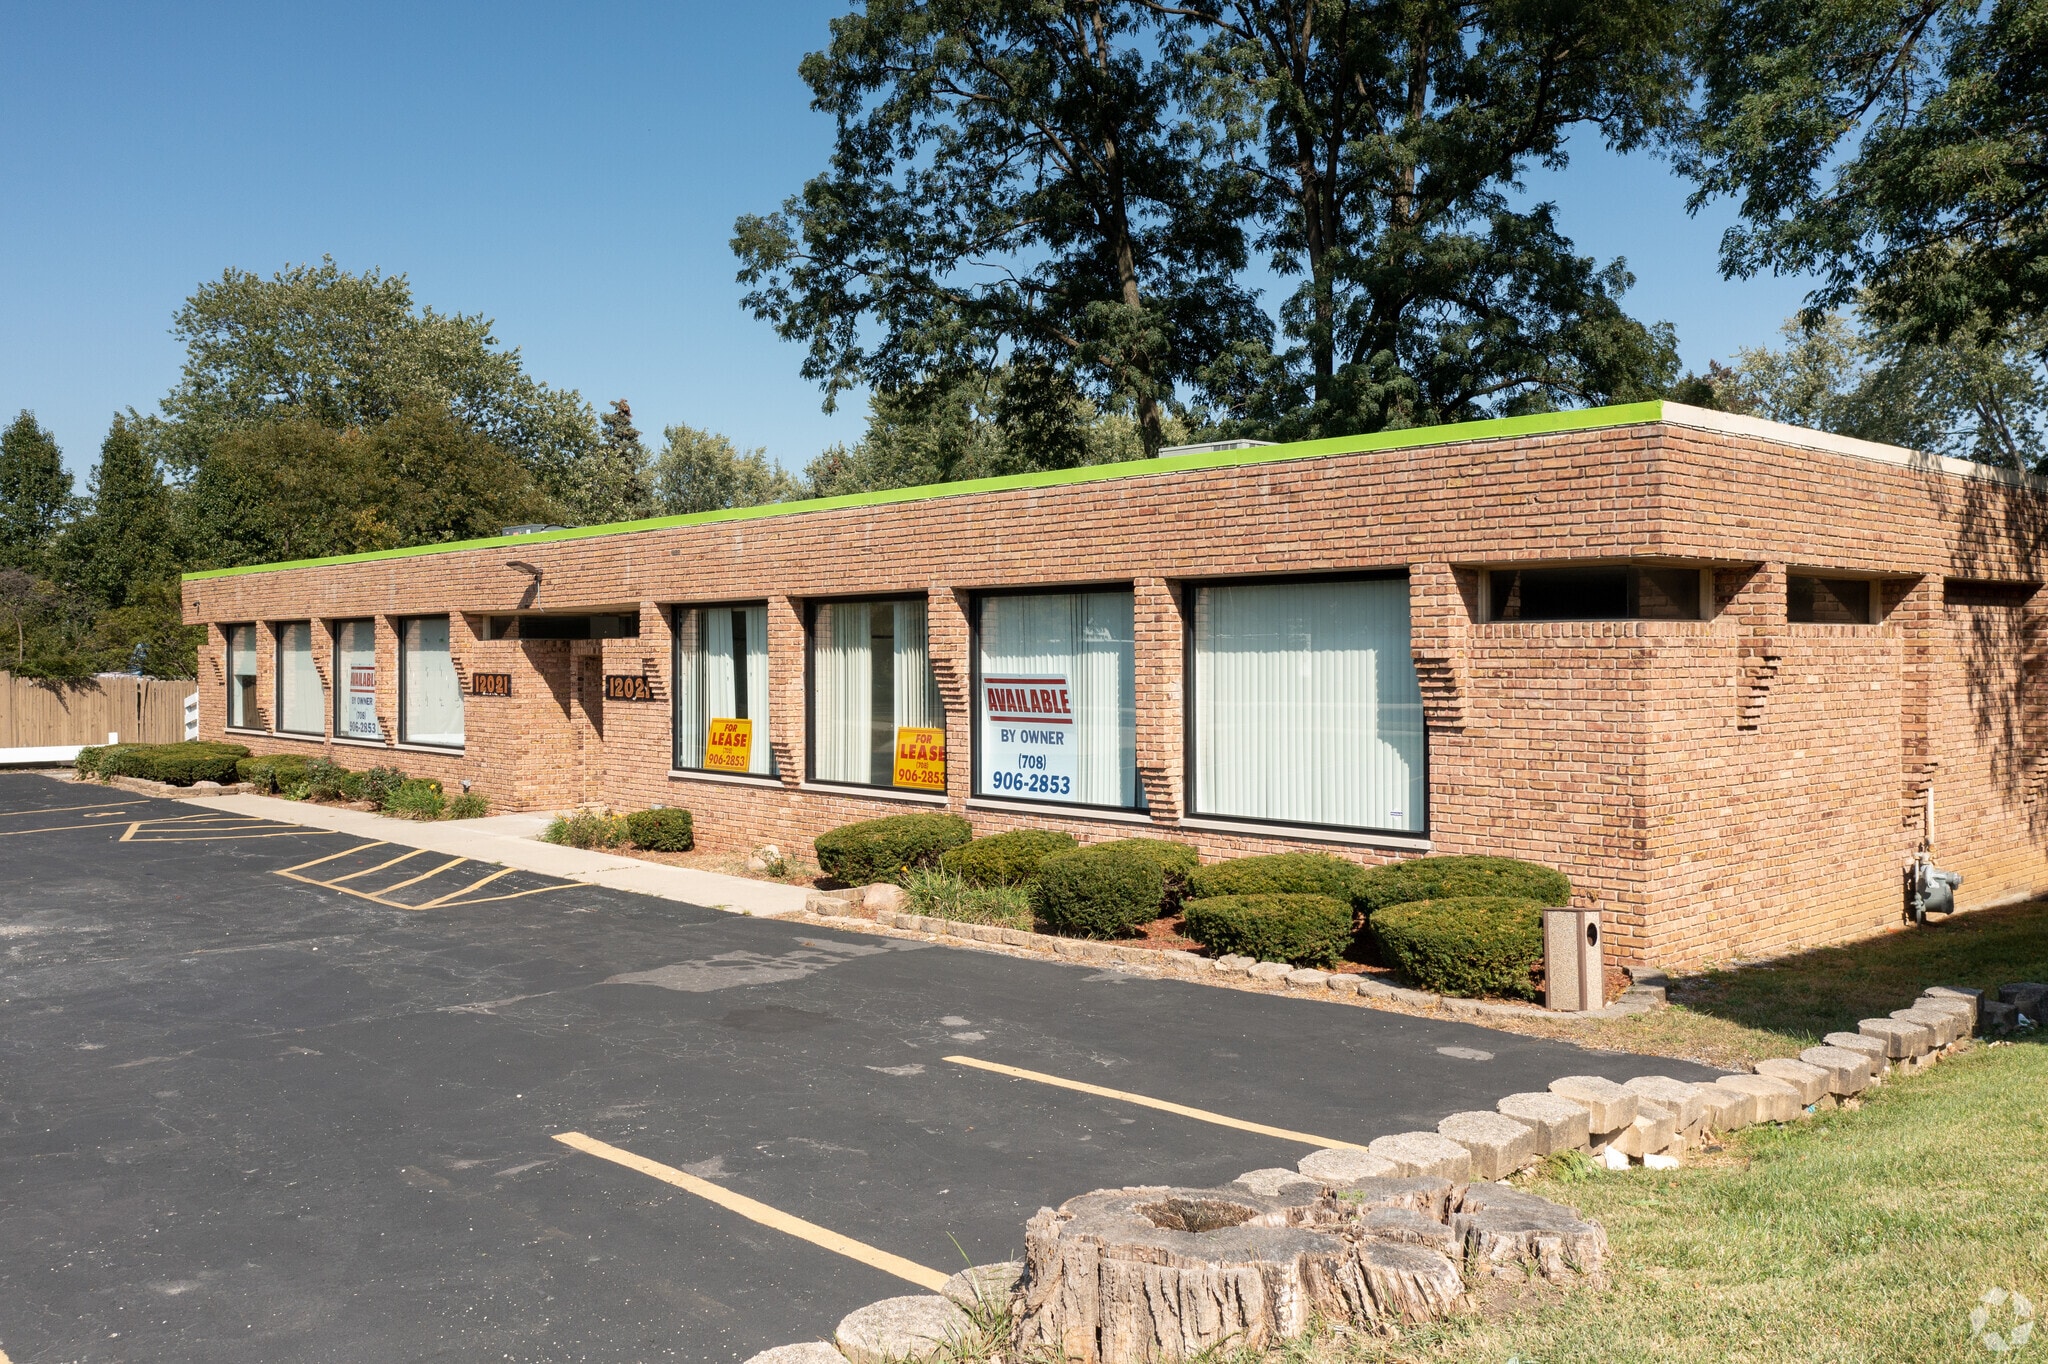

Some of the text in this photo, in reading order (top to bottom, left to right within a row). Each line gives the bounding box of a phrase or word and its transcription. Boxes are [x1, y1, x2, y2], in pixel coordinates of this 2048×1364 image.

[350, 672, 374, 687] AVAILABL
[475, 675, 508, 694] 12021
[357, 697, 373, 706] OWNER
[987, 688, 1071, 714] AVAILABLE
[349, 721, 376, 733] 906-2853
[724, 723, 738, 732] FOR
[711, 732, 748, 747] LEASE
[915, 733, 933, 744] FOR
[1001, 729, 1064, 745] BY OWNER
[708, 753, 746, 767] 906-2853
[900, 743, 945, 762] LEASE
[1018, 753, 1047, 770] (708)
[898, 768, 945, 784] 906-2853
[993, 771, 1070, 795] 906-2853
